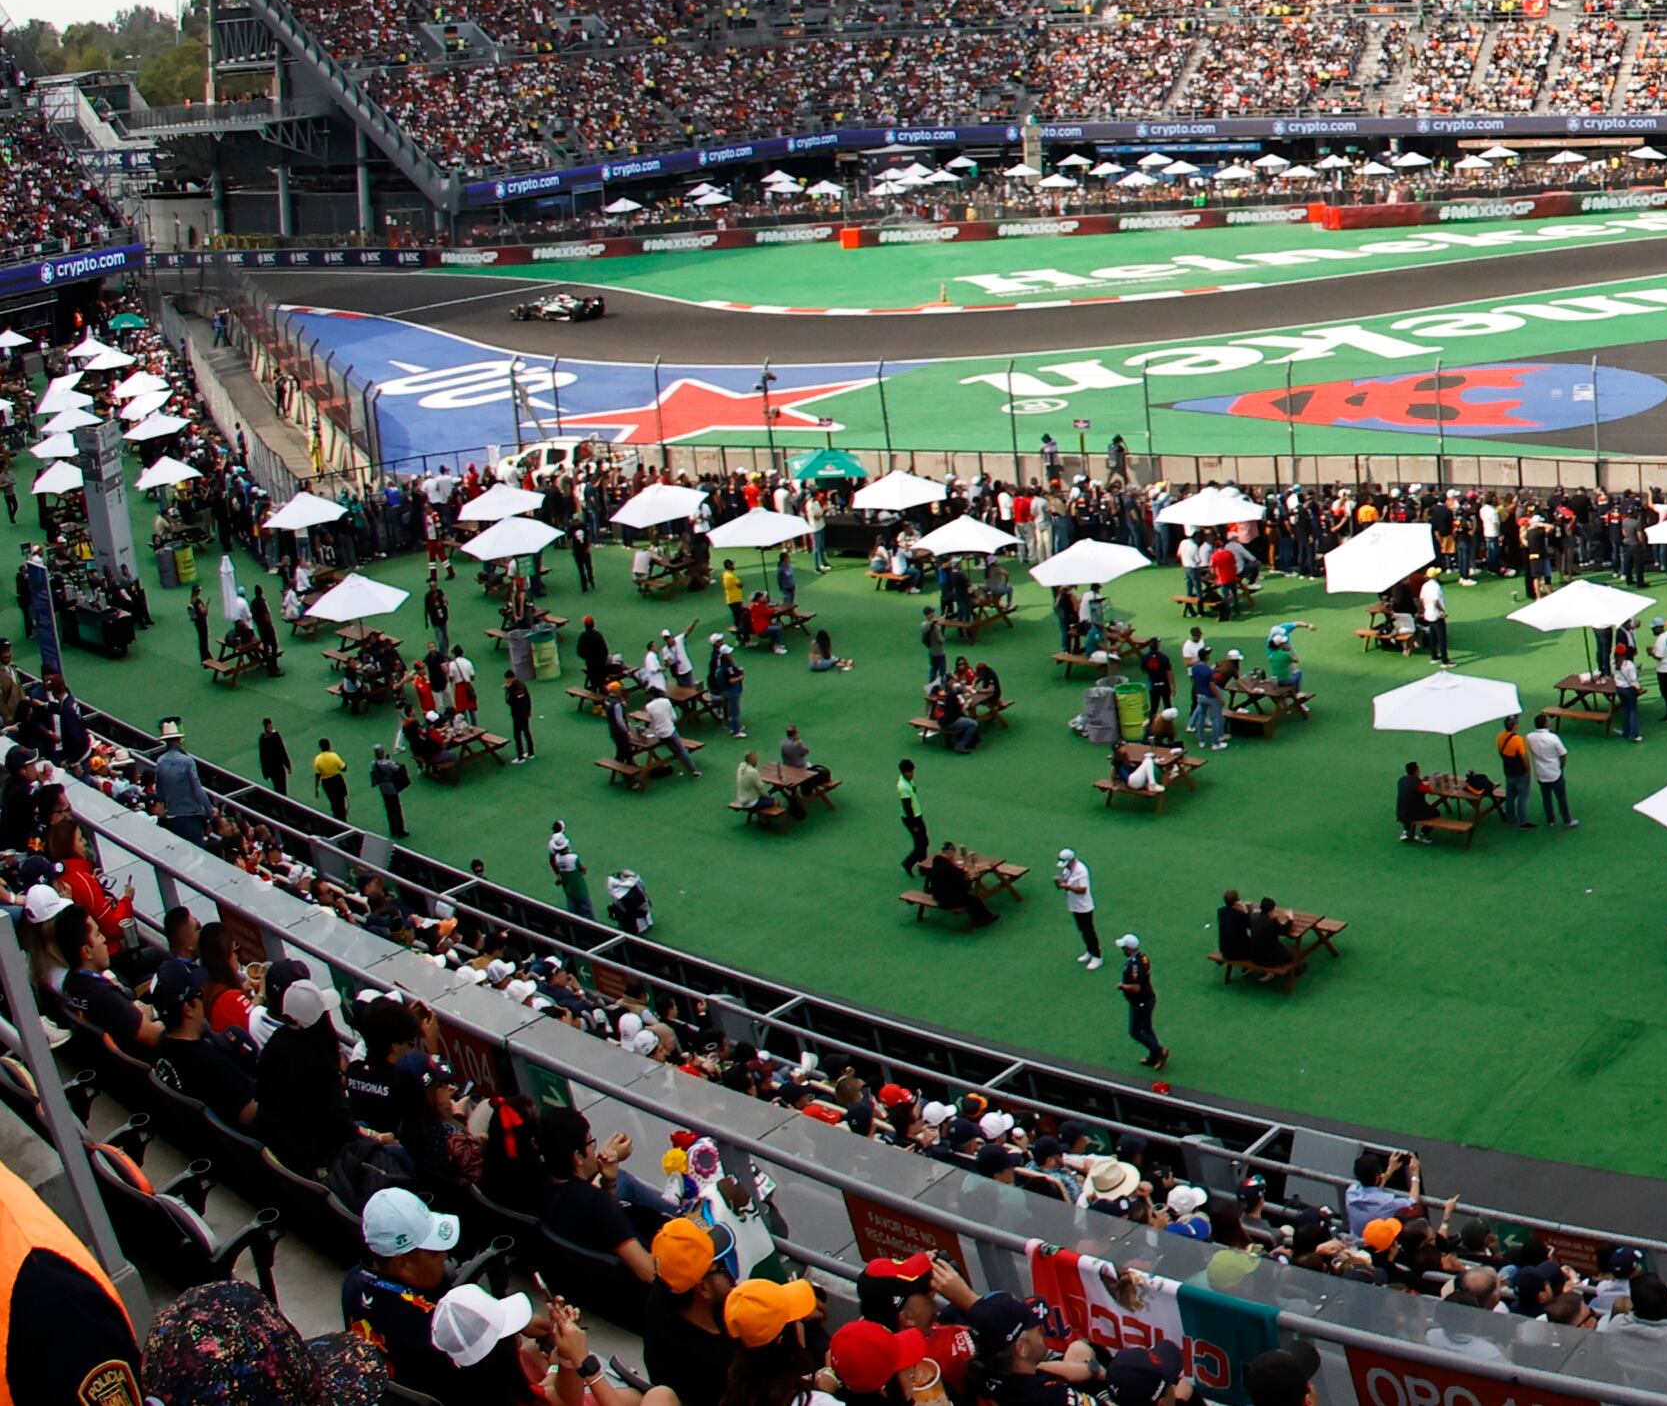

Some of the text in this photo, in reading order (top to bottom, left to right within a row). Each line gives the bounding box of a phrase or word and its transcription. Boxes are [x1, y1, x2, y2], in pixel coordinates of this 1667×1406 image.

[1150, 123, 1216, 137] crypto.com
[1287, 120, 1357, 135] crypto.com
[1432, 118, 1504, 132] crypto.com
[1583, 117, 1657, 130] crypto.com
[796, 133, 838, 150] crypto.com
[898, 129, 956, 144] crypto.com
[709, 146, 753, 164] crypto.com
[612, 158, 660, 180] crypto.com
[507, 174, 560, 196] crypto.com
[1439, 200, 1535, 221] #MexicoGP
[57, 251, 125, 278] crypto.com
[348, 1078, 390, 1097] PETRONAS
[867, 1211, 937, 1247] FAVOR DE NO
[88, 1370, 127, 1401] POLICIA
